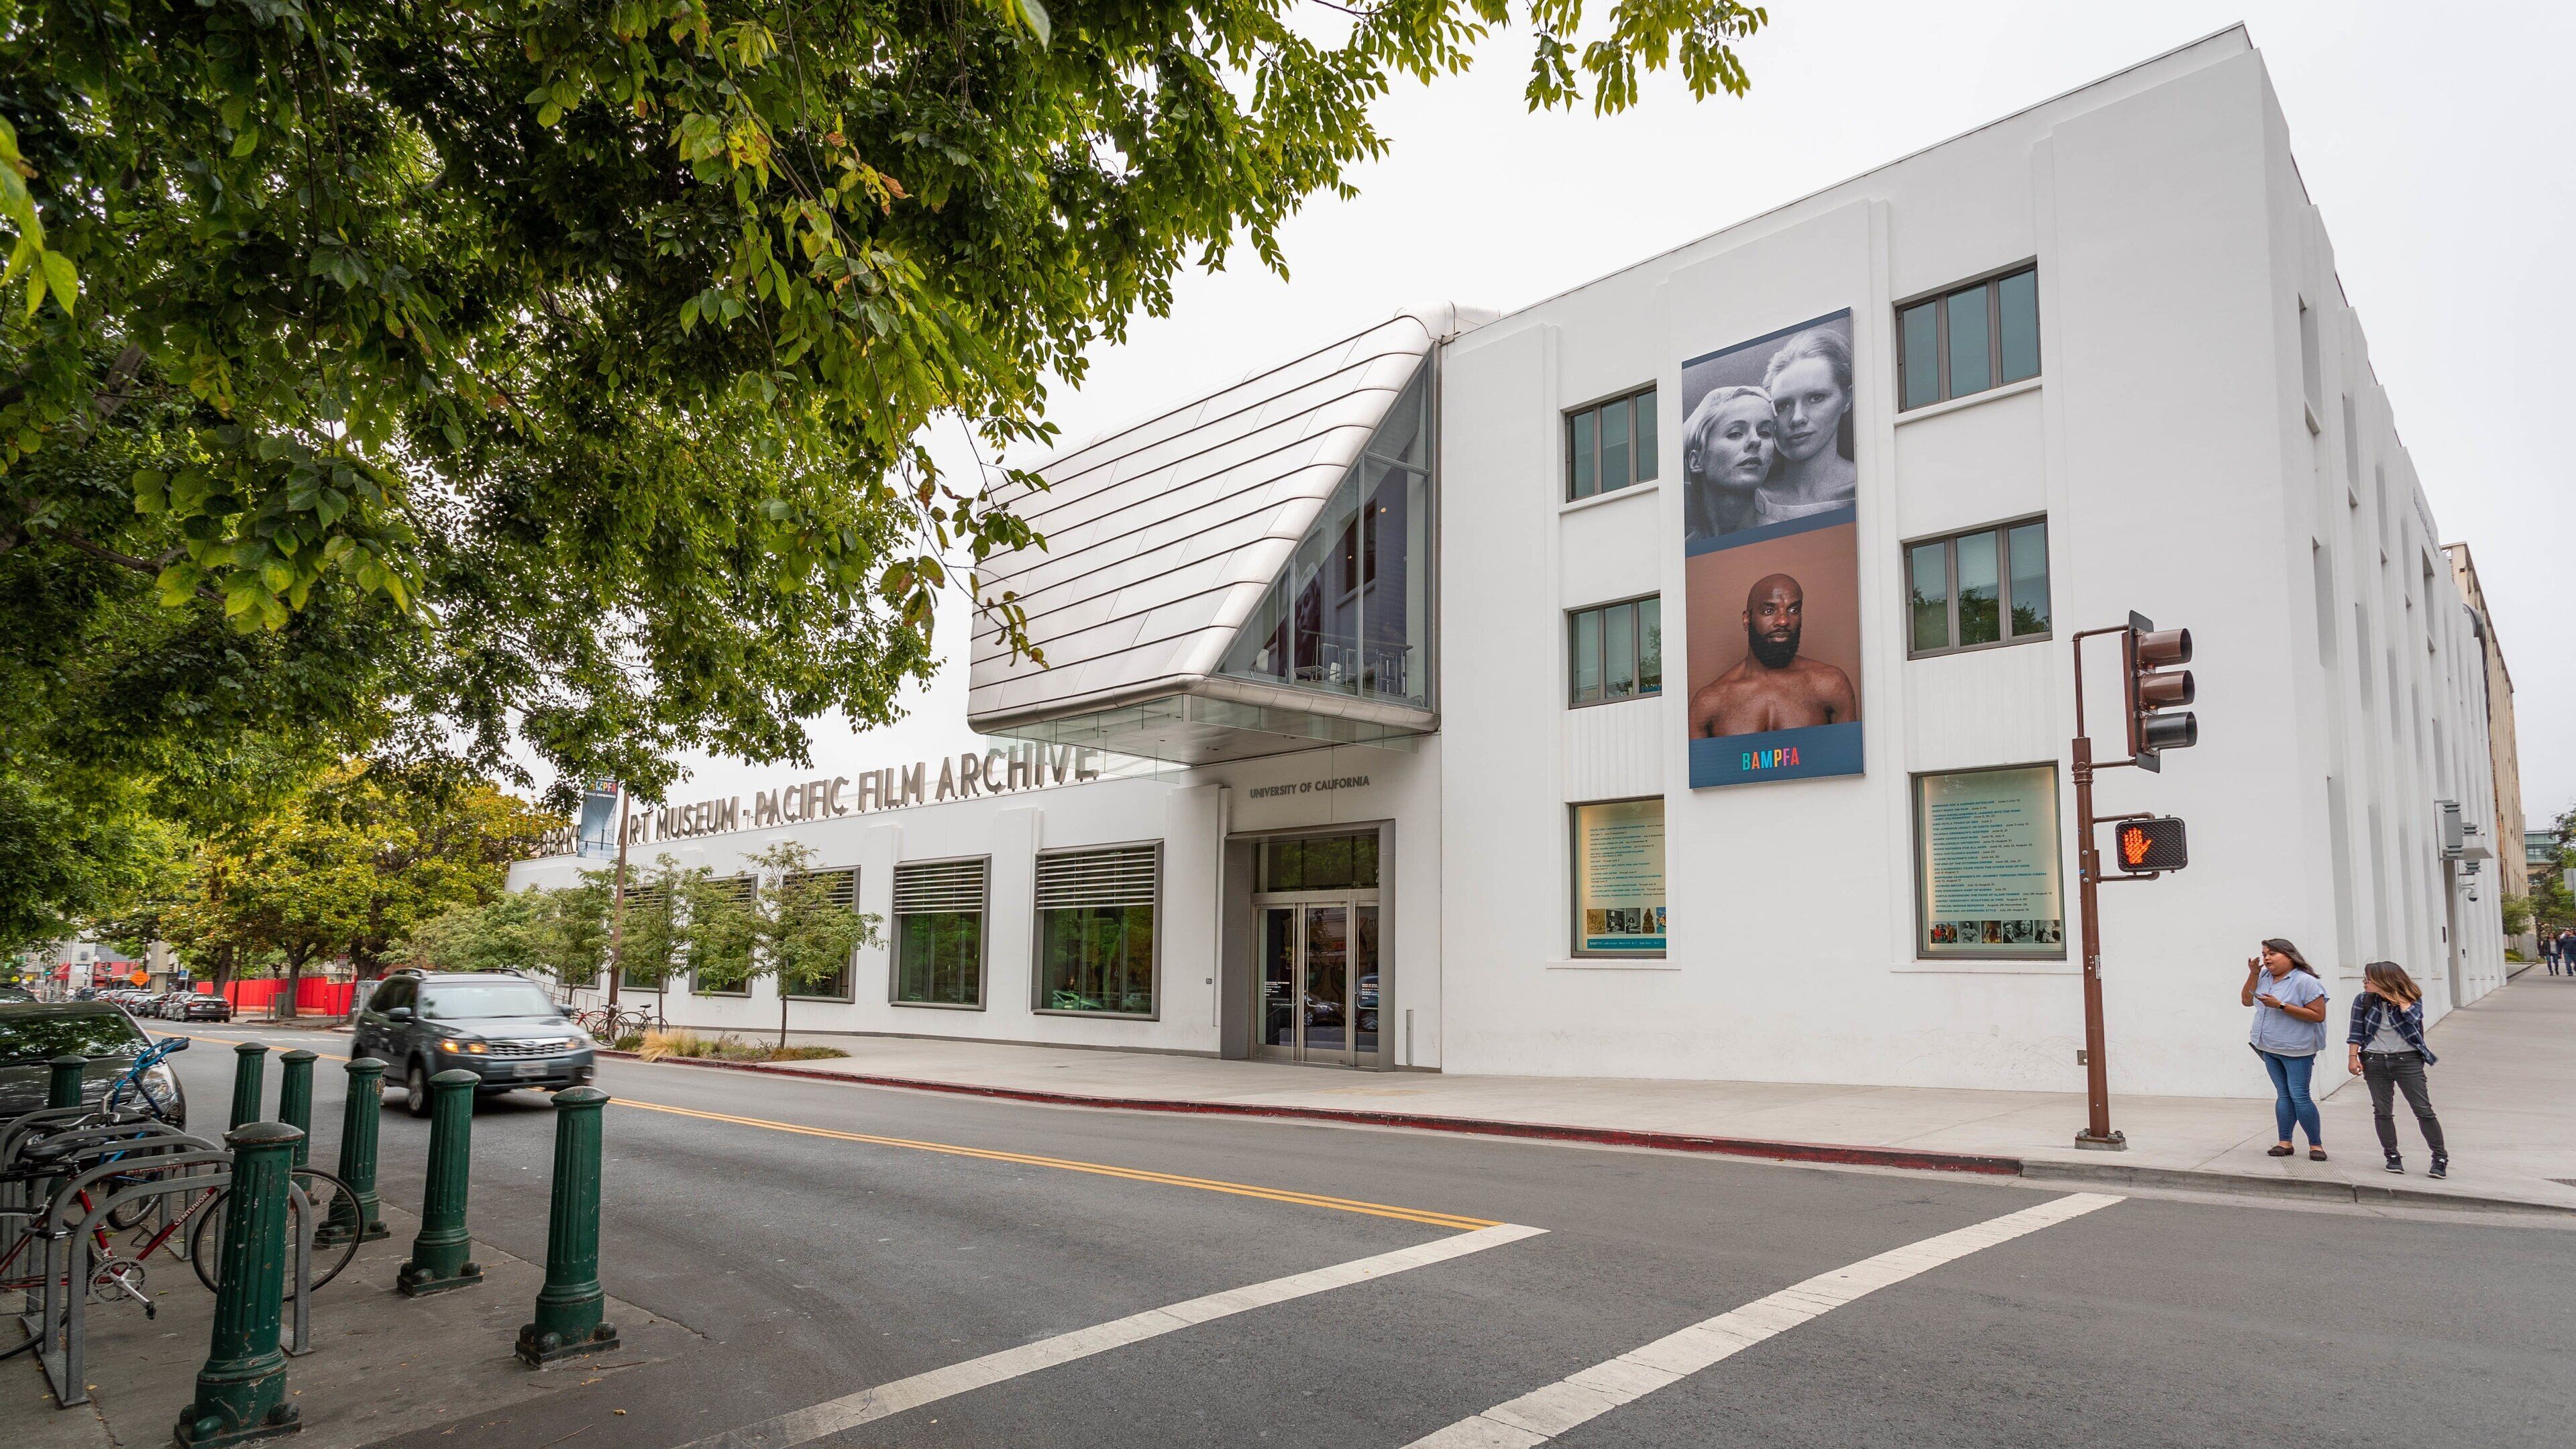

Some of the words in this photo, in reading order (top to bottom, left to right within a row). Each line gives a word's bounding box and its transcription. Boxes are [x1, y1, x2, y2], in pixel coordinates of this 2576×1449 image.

[1742, 747, 1800, 770] BAMPFA
[656, 796, 740, 840] MUSEUM
[755, 776, 850, 826] PACIFIC
[859, 762, 925, 812] FILM
[935, 741, 1099, 800] ARCHIVE
[1250, 784, 1297, 799] UNIVERSITY
[1299, 782, 1311, 793] OF
[1315, 775, 1370, 791] CALIFORNIA
[174, 1192, 210, 1226] CENTURION
